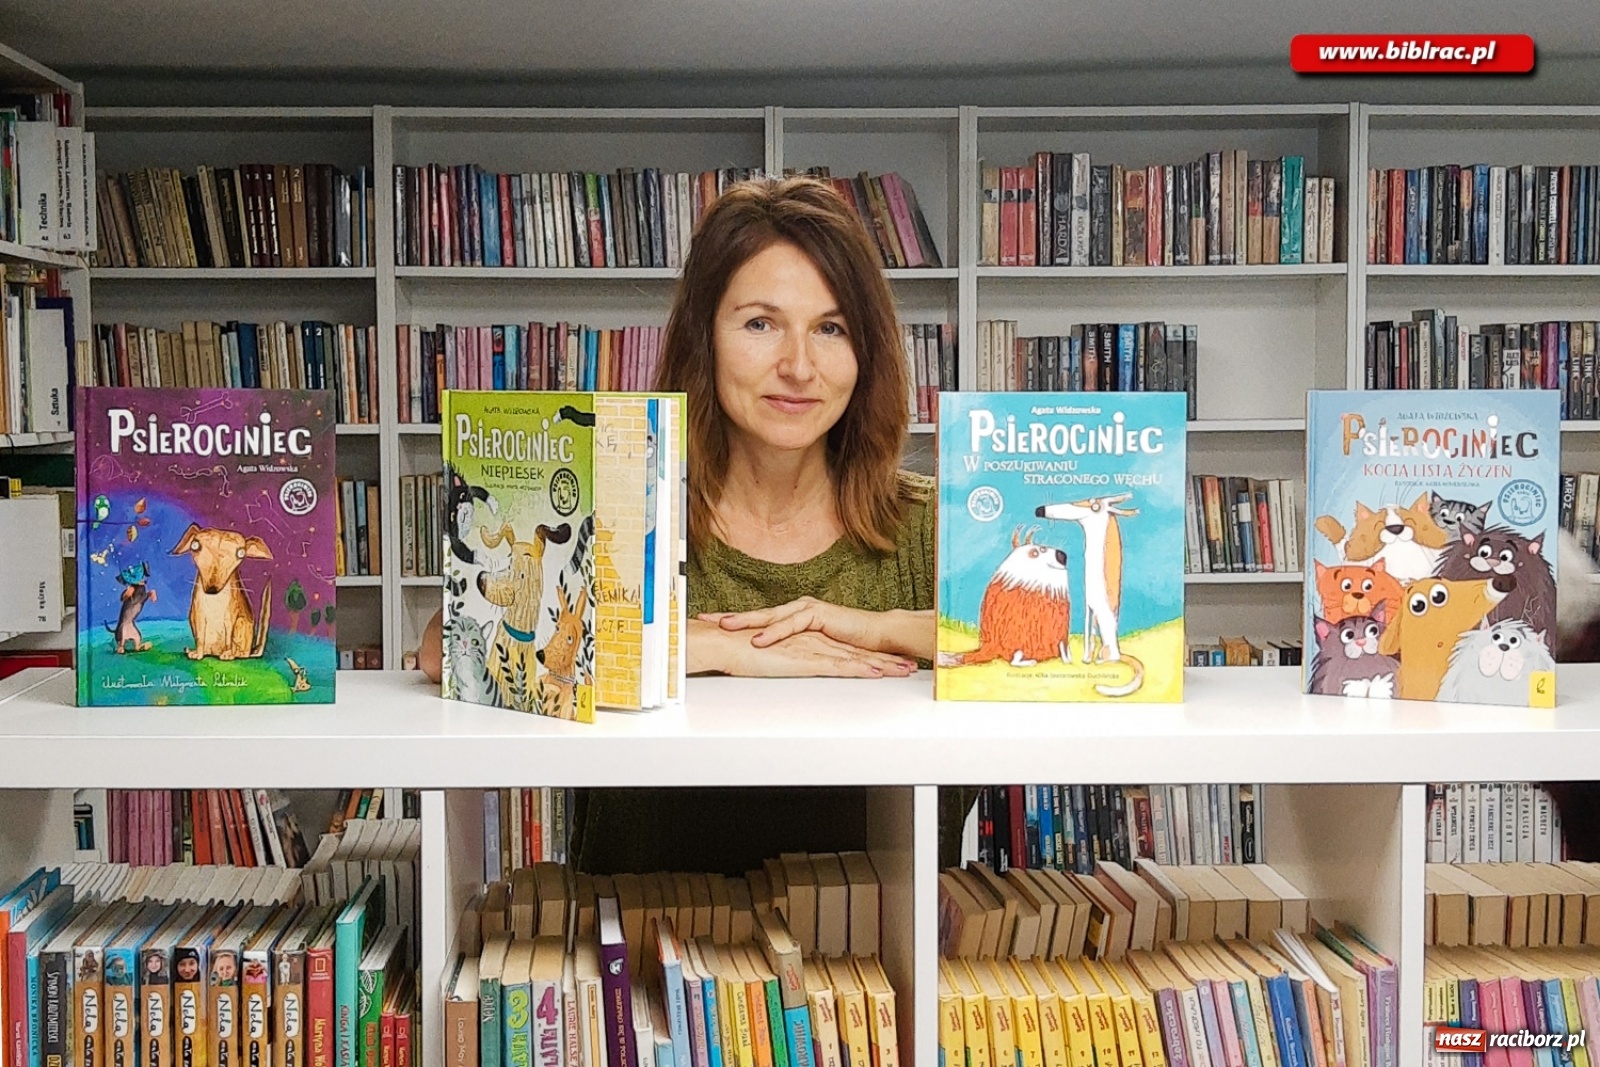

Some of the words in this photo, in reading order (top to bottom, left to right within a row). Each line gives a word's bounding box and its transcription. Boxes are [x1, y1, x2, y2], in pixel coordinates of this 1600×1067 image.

[37, 193, 48, 231] Technika
[1056, 215, 1069, 256] HARDA
[315, 328, 322, 336] 2
[1088, 331, 1096, 362] SMITH
[1103, 331, 1112, 363] SMITH
[1123, 331, 1134, 362] SMITH
[1572, 356, 1580, 379] LINK
[1585, 356, 1593, 379] LINK
[49, 387, 59, 416] Sztuka
[1031, 405, 1055, 416] Agata
[1396, 411, 1425, 421] AGATA
[237, 464, 258, 475] Agata
[480, 464, 545, 481] NIEPIESEK
[963, 454, 981, 472] W
[983, 459, 1079, 472] POSZUKIWANIU
[1363, 463, 1409, 478] KOCIA
[1413, 463, 1454, 478] LISTA
[1023, 473, 1110, 486] STRACONEGO
[1113, 473, 1163, 487] WĘCHU
[1562, 476, 1574, 510] MRÓZ
[1505, 804, 1513, 844] UPIORY
[1521, 804, 1530, 840] POLICJA
[30, 976, 39, 1011] MONIKA
[536, 986, 559, 1026] 4
[84, 992, 98, 1030] Nela
[114, 995, 128, 1034] Nela
[149, 994, 163, 1033] Nela
[182, 992, 195, 1031] Nela
[218, 995, 232, 1034] Nela
[249, 996, 263, 1035] Nela
[285, 995, 299, 1034] Nela
[339, 1004, 350, 1033] KINGA
[505, 989, 530, 1030] 3
[567, 1000, 578, 1031] LAURIE
[312, 1018, 327, 1053] Martyna
[568, 1032, 579, 1063] HALSE
[340, 1039, 351, 1067] KASIA
[619, 1045, 628, 1067] POLSC
